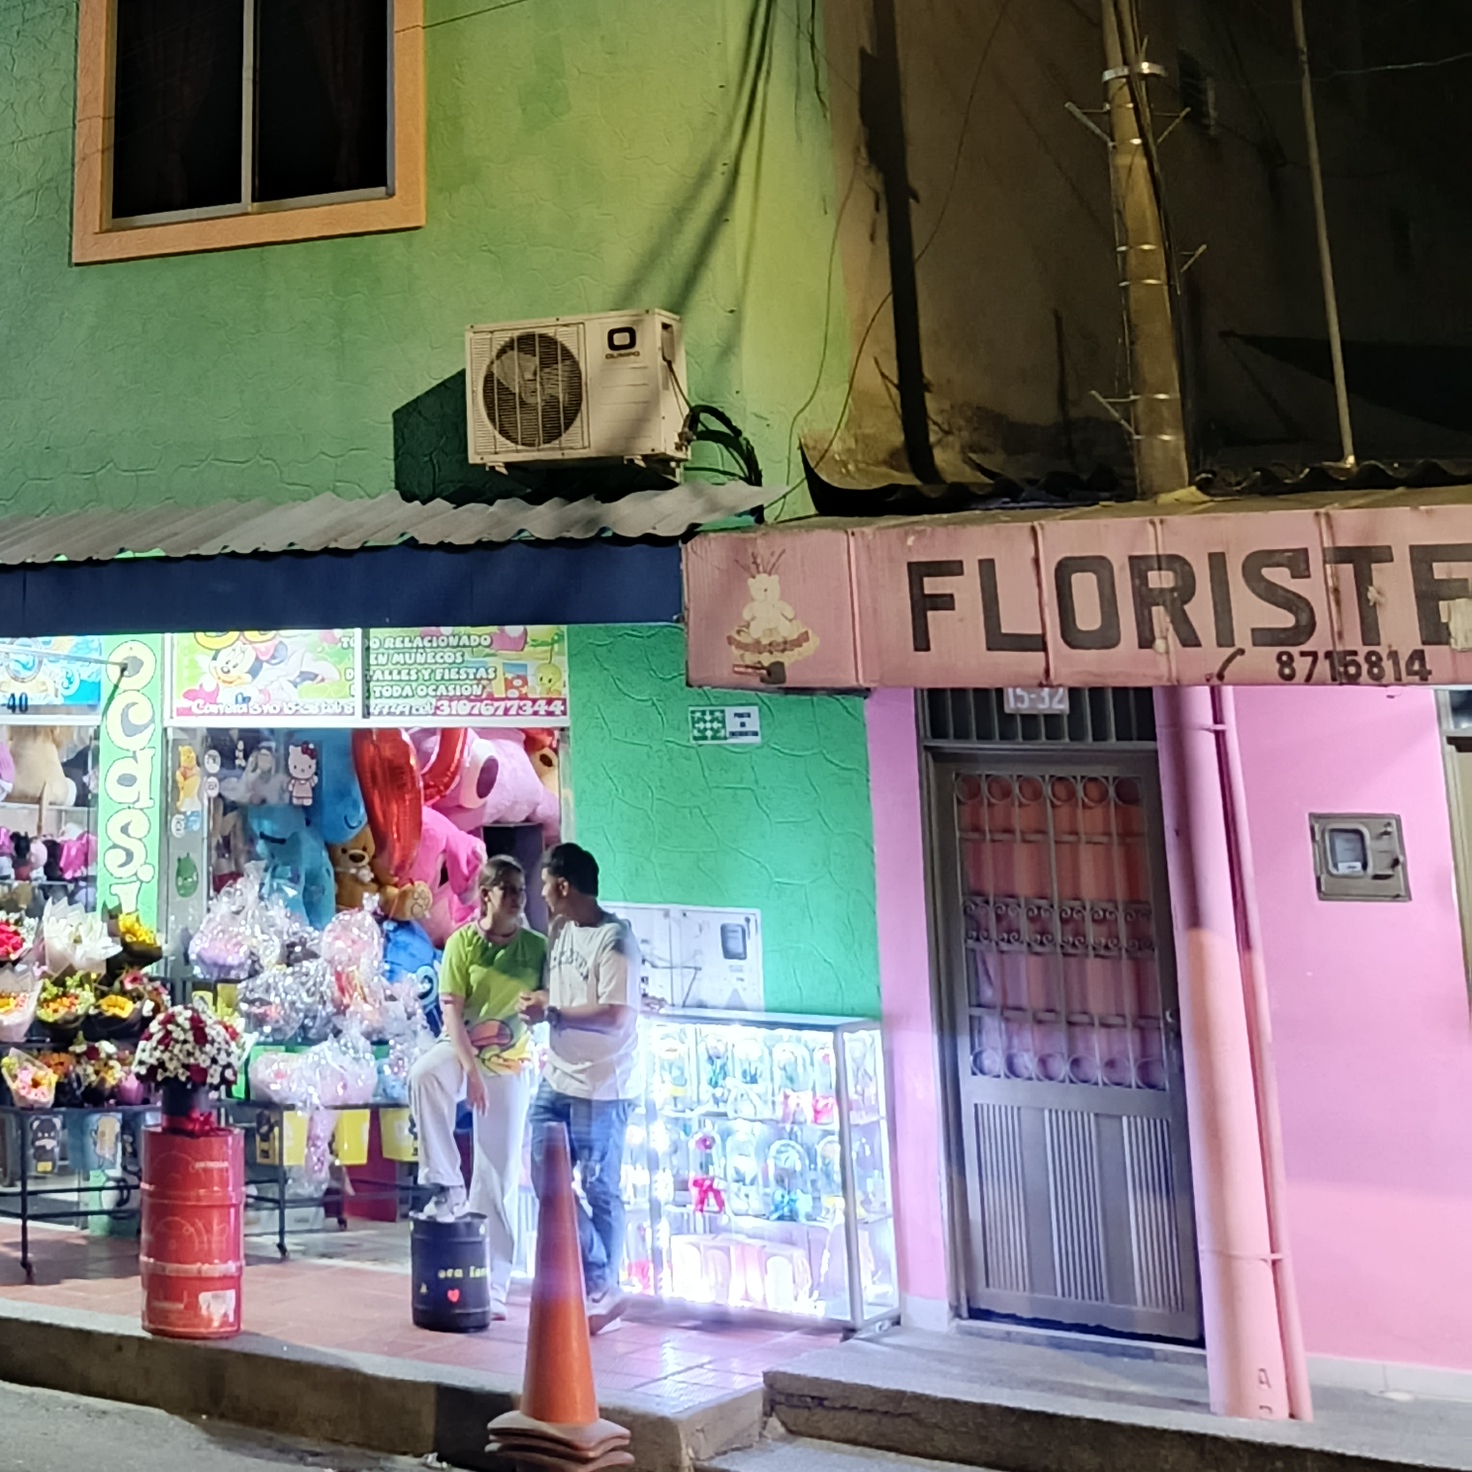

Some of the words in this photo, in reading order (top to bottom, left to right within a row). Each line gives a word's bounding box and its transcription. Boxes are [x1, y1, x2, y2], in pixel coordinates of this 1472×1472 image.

[383, 634, 492, 650] RELACIONADO
[391, 649, 465, 665] MUÑECOS
[420, 667, 432, 680] Y
[435, 666, 498, 681] FIESTAS
[373, 684, 414, 698] TODA
[1008, 687, 1065, 709] 15-32
[436, 699, 564, 716] 3107677344
